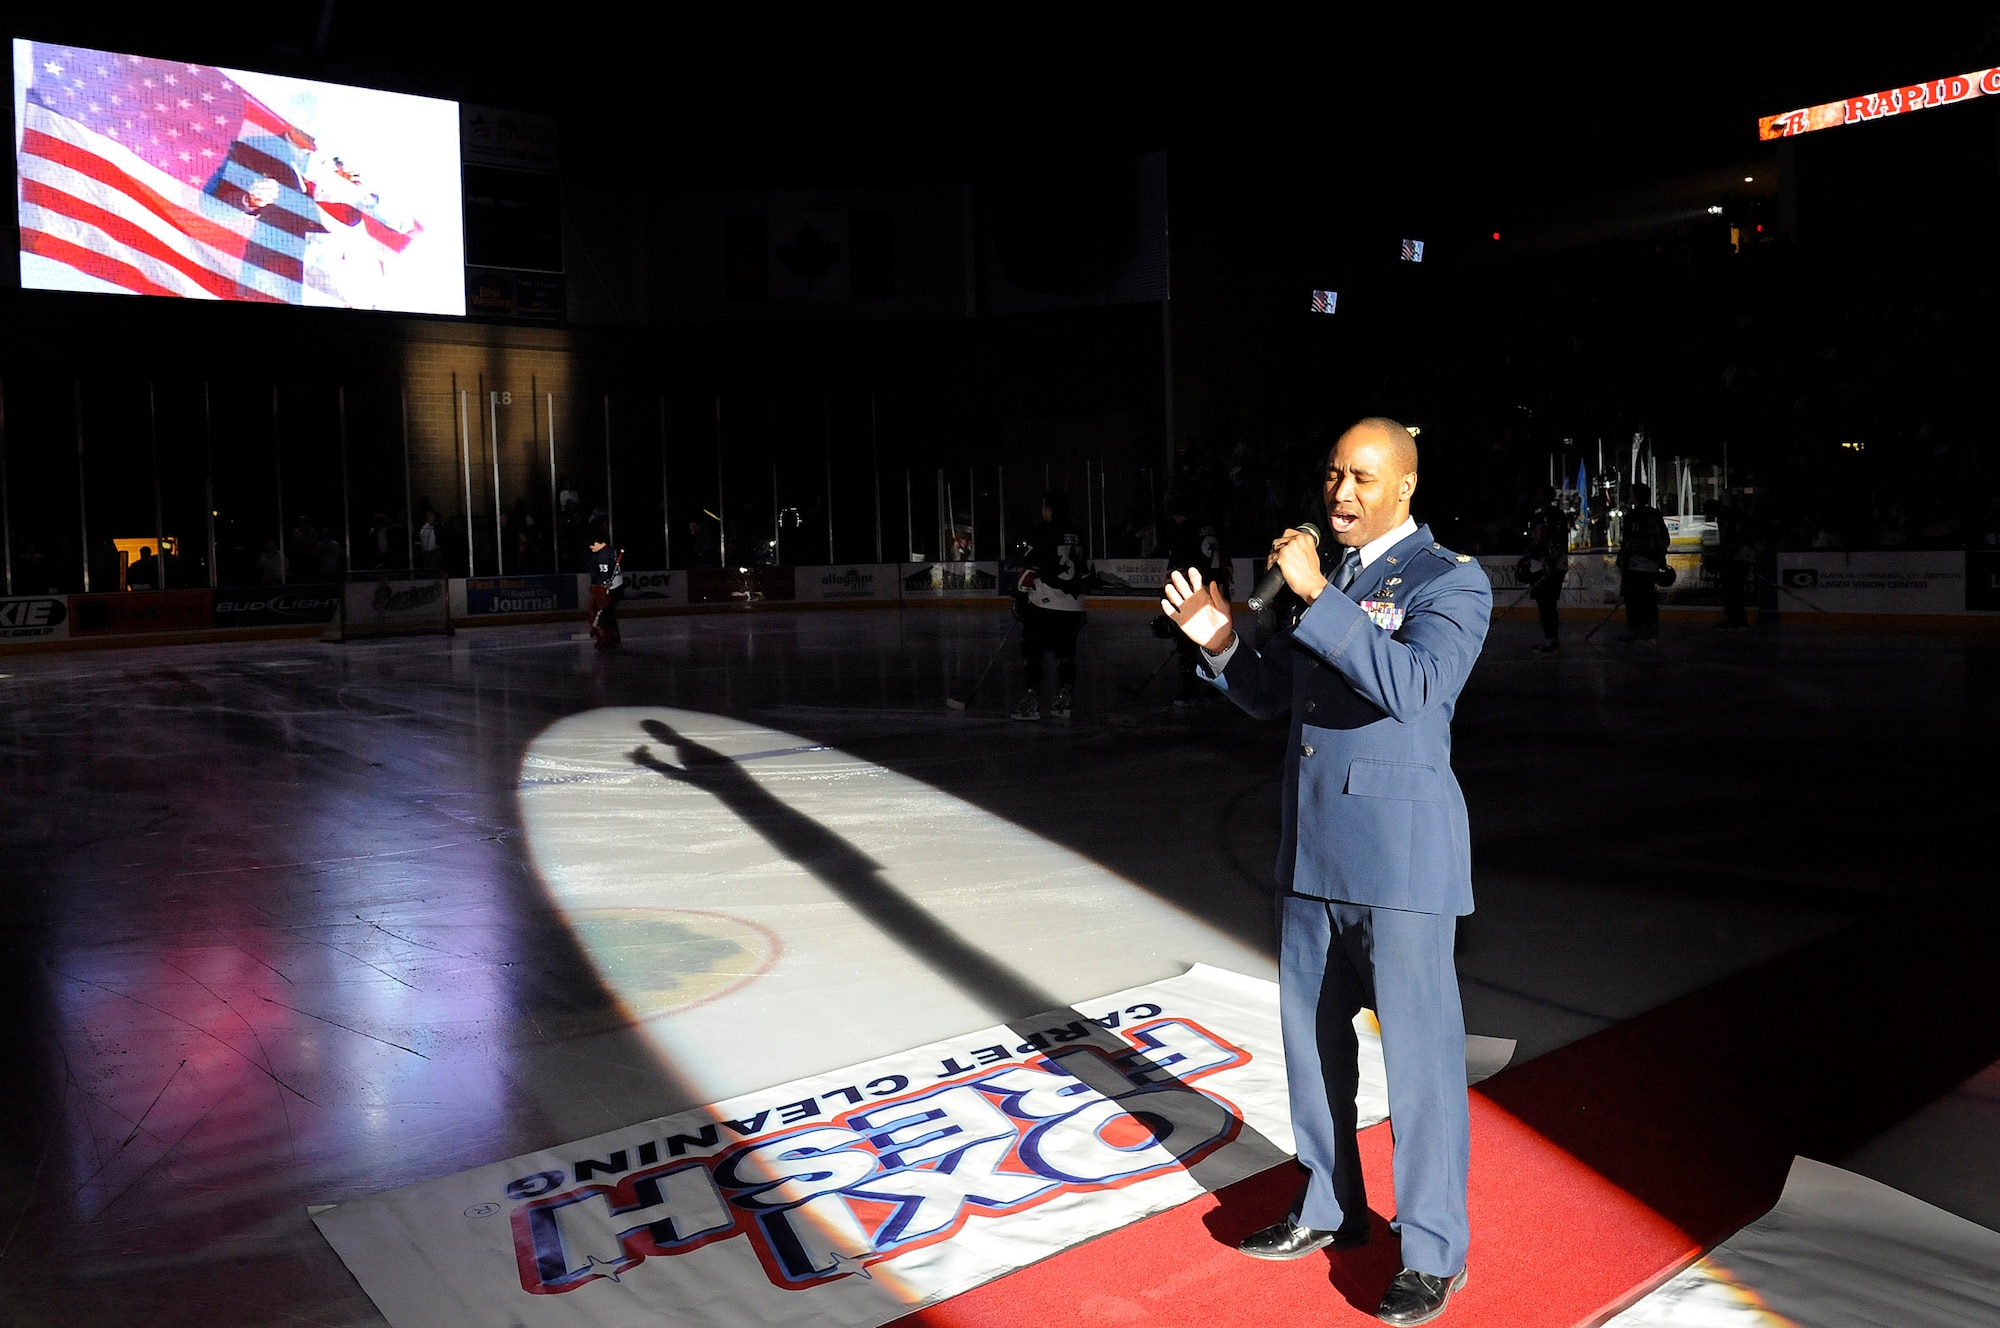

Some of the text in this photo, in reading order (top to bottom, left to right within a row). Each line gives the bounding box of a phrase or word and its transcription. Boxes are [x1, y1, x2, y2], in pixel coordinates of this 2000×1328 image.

[1844, 75, 1972, 125] RAPID
[479, 285, 502, 298] Best
[472, 295, 513, 309] Western
[822, 573, 874, 586] allegiant
[510, 587, 535, 600] Rapid
[215, 601, 265, 613] BUD
[278, 597, 340, 610] LIGHT
[489, 593, 558, 612] Journal
[12, 627, 54, 637] GROUP
[937, 1003, 1162, 1078] CARPET
[506, 1075, 909, 1199] CLEANING
[530, 1021, 1238, 1285] FRESH
[757, 1087, 1233, 1282] OXI
